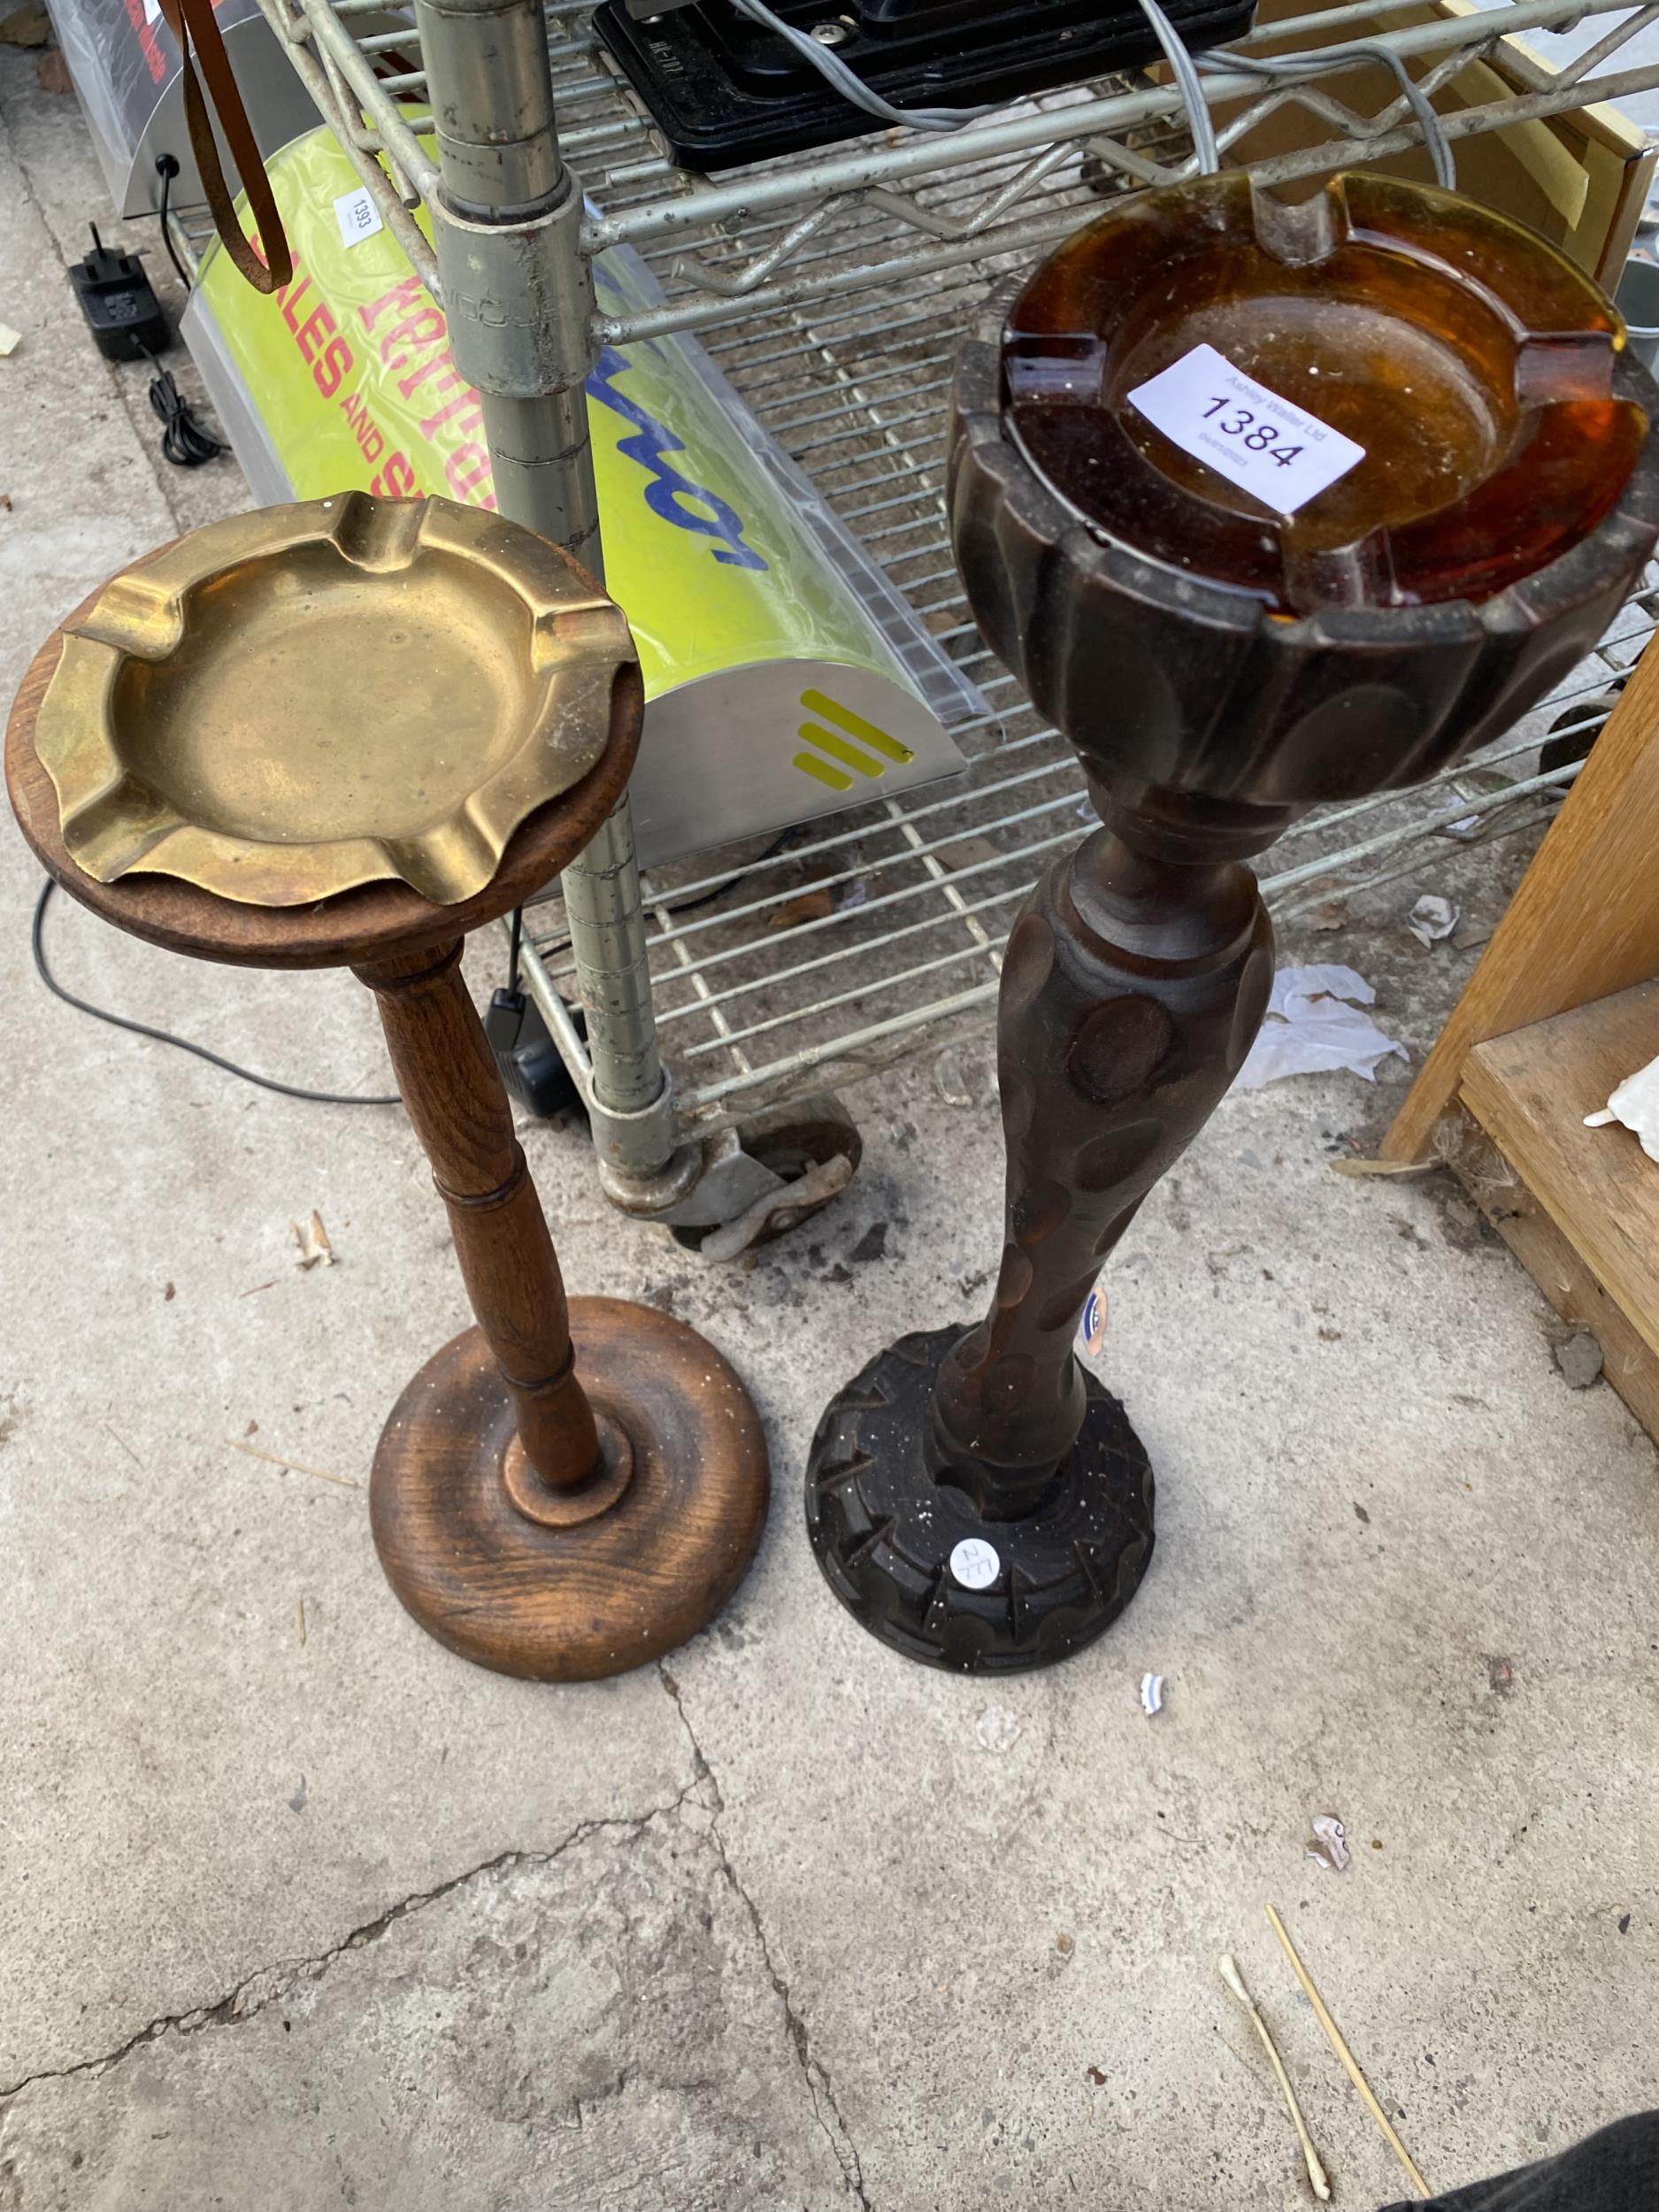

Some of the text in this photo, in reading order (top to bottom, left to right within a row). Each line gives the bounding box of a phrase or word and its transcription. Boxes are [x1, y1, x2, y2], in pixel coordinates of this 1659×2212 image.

[354, 199, 372, 228] 1393
[1202, 396, 1304, 467] 1384
[1225, 375, 1267, 405] Ashley
[1305, 422, 1328, 442] Ltd
[340, 394, 384, 464] AND
[371, 451, 426, 500] S
